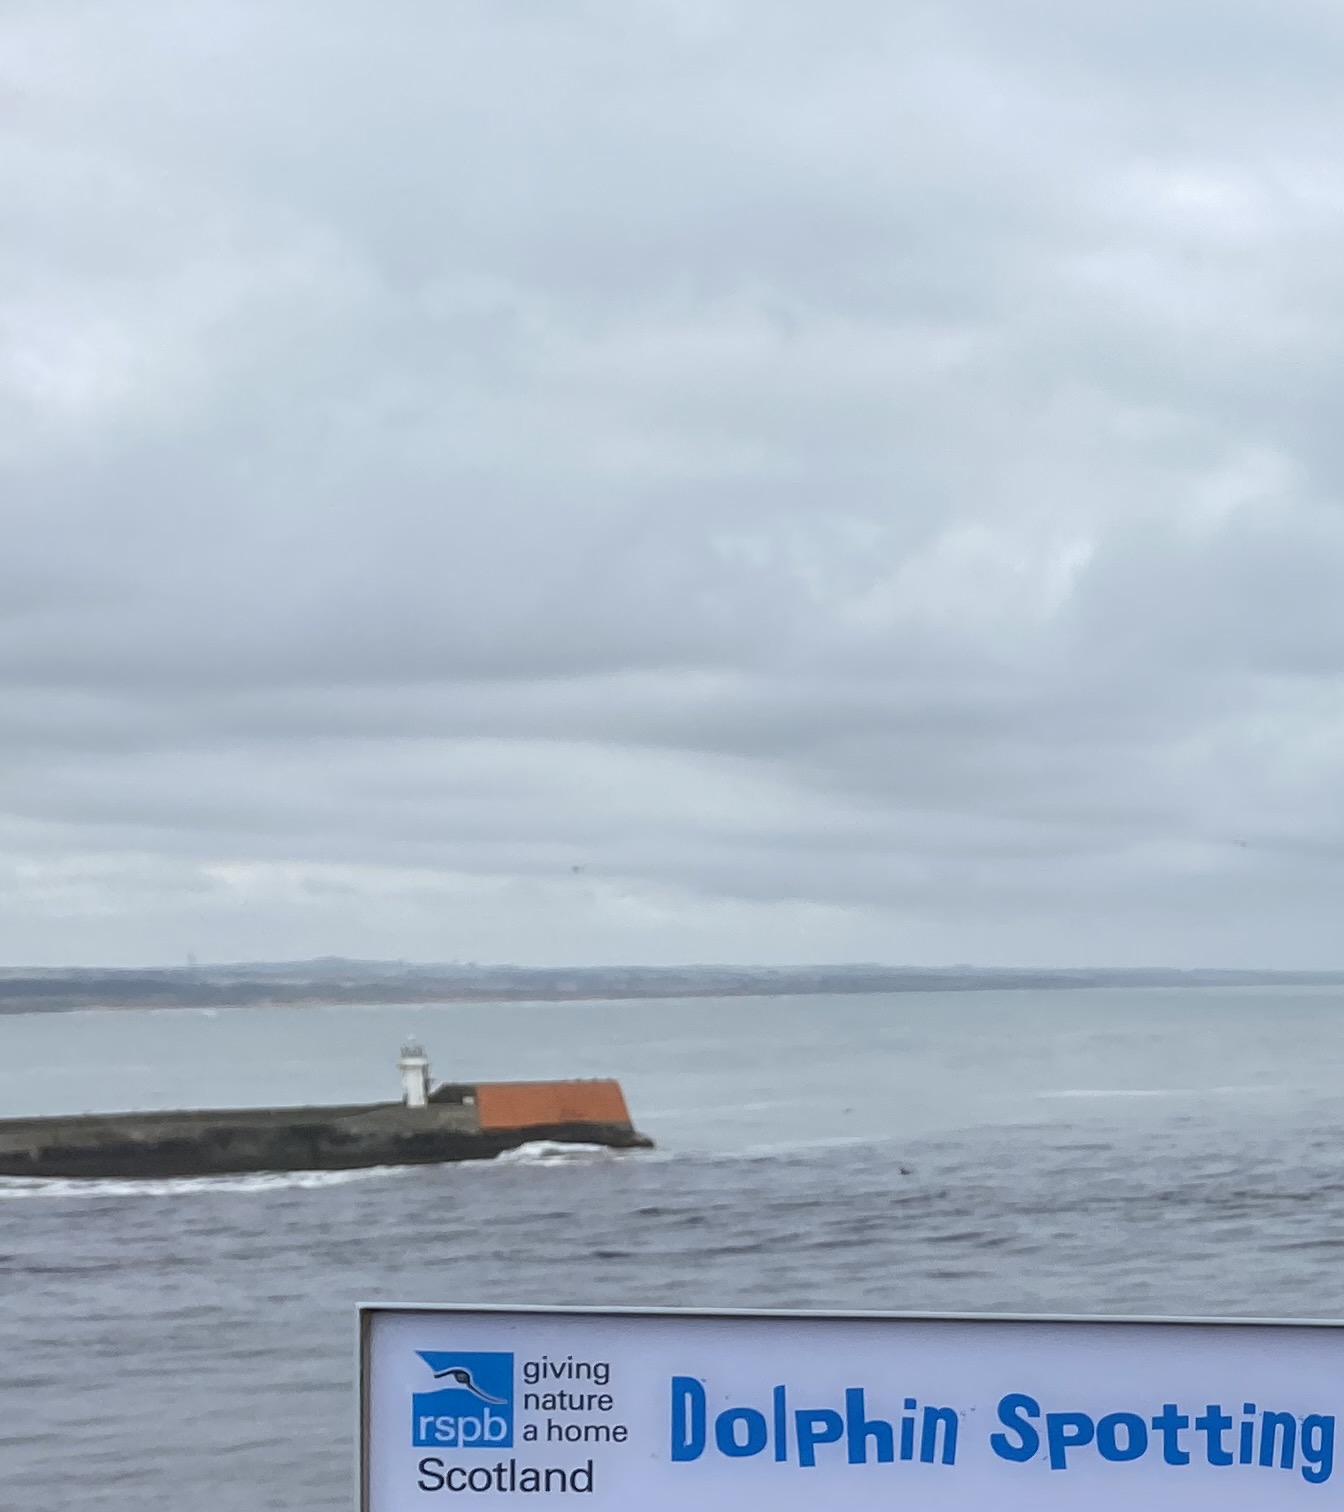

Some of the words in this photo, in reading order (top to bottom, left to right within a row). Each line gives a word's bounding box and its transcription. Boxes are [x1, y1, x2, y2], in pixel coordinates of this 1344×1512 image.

[524, 1356, 609, 1385] giving
[524, 1390, 613, 1411] nature
[418, 1407, 508, 1445] rspb
[523, 1424, 537, 1441] a
[548, 1419, 628, 1442] home
[671, 1376, 958, 1467] Dolphin
[990, 1394, 1335, 1484] Spotting
[418, 1458, 593, 1492] Scotland
